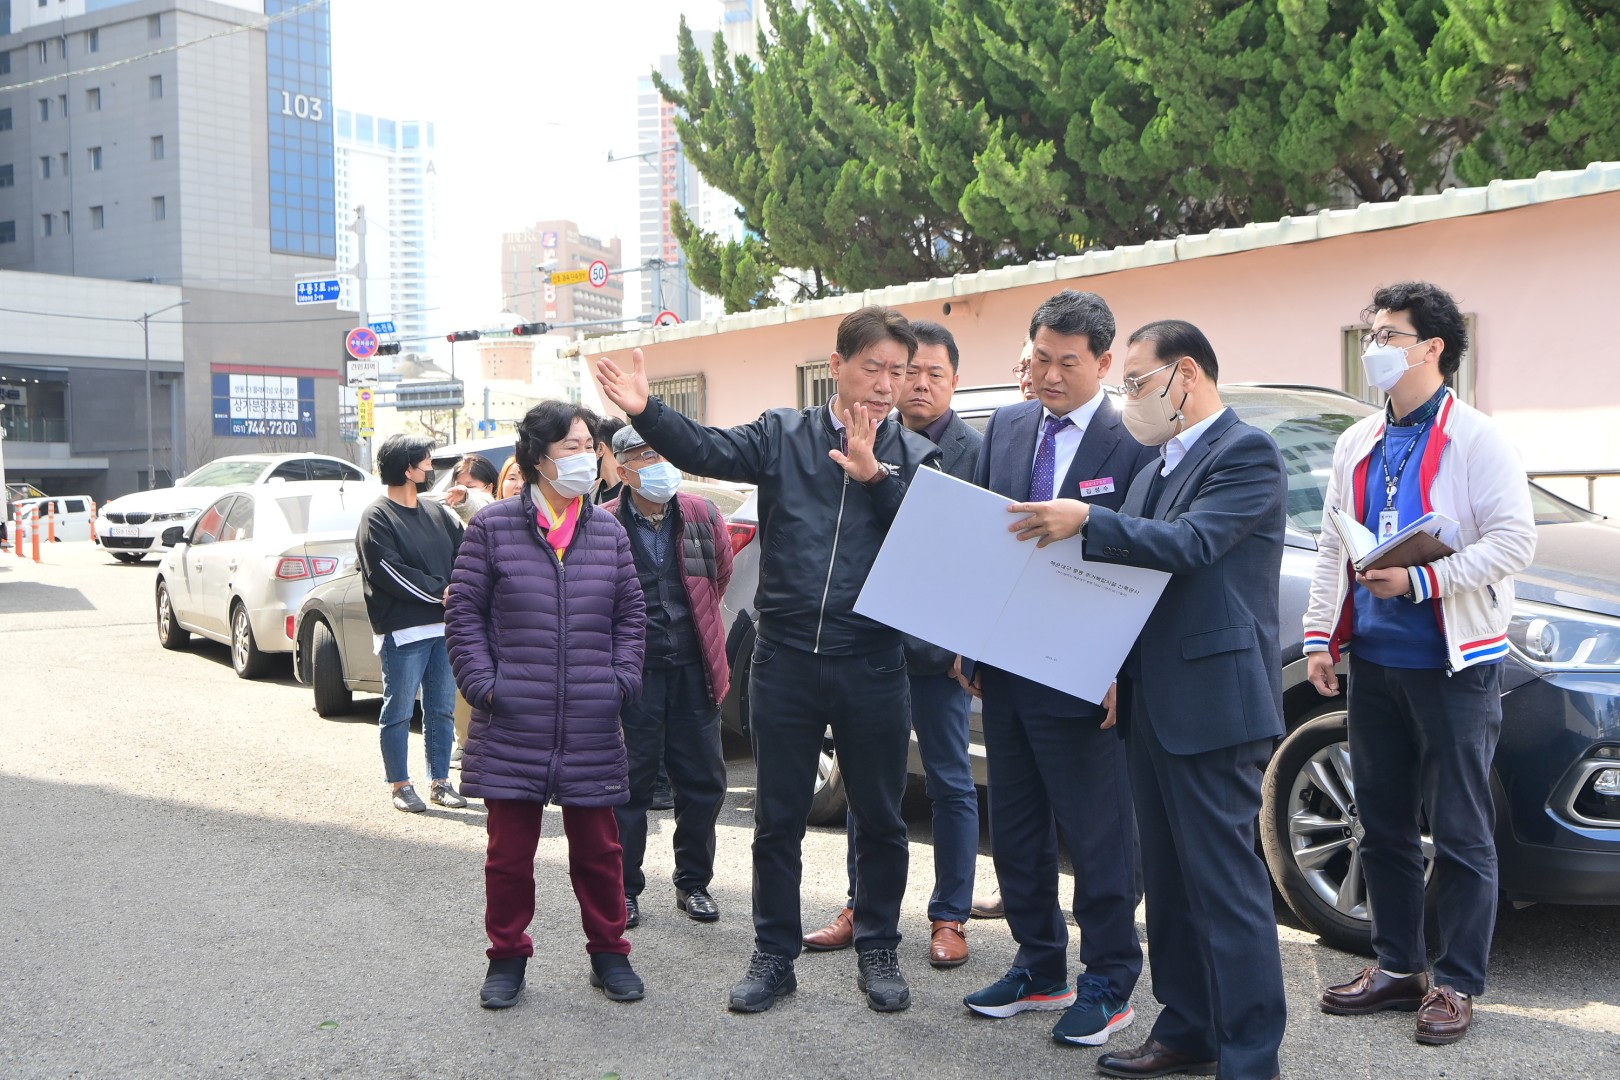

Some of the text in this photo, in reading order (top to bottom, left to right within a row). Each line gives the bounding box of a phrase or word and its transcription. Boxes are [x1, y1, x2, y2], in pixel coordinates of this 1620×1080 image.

[281, 91, 323, 121] 103
[593, 267, 605, 281] 50
[234, 399, 295, 414] 상가분양홍보관
[1049, 560, 1072, 571] 해운대구
